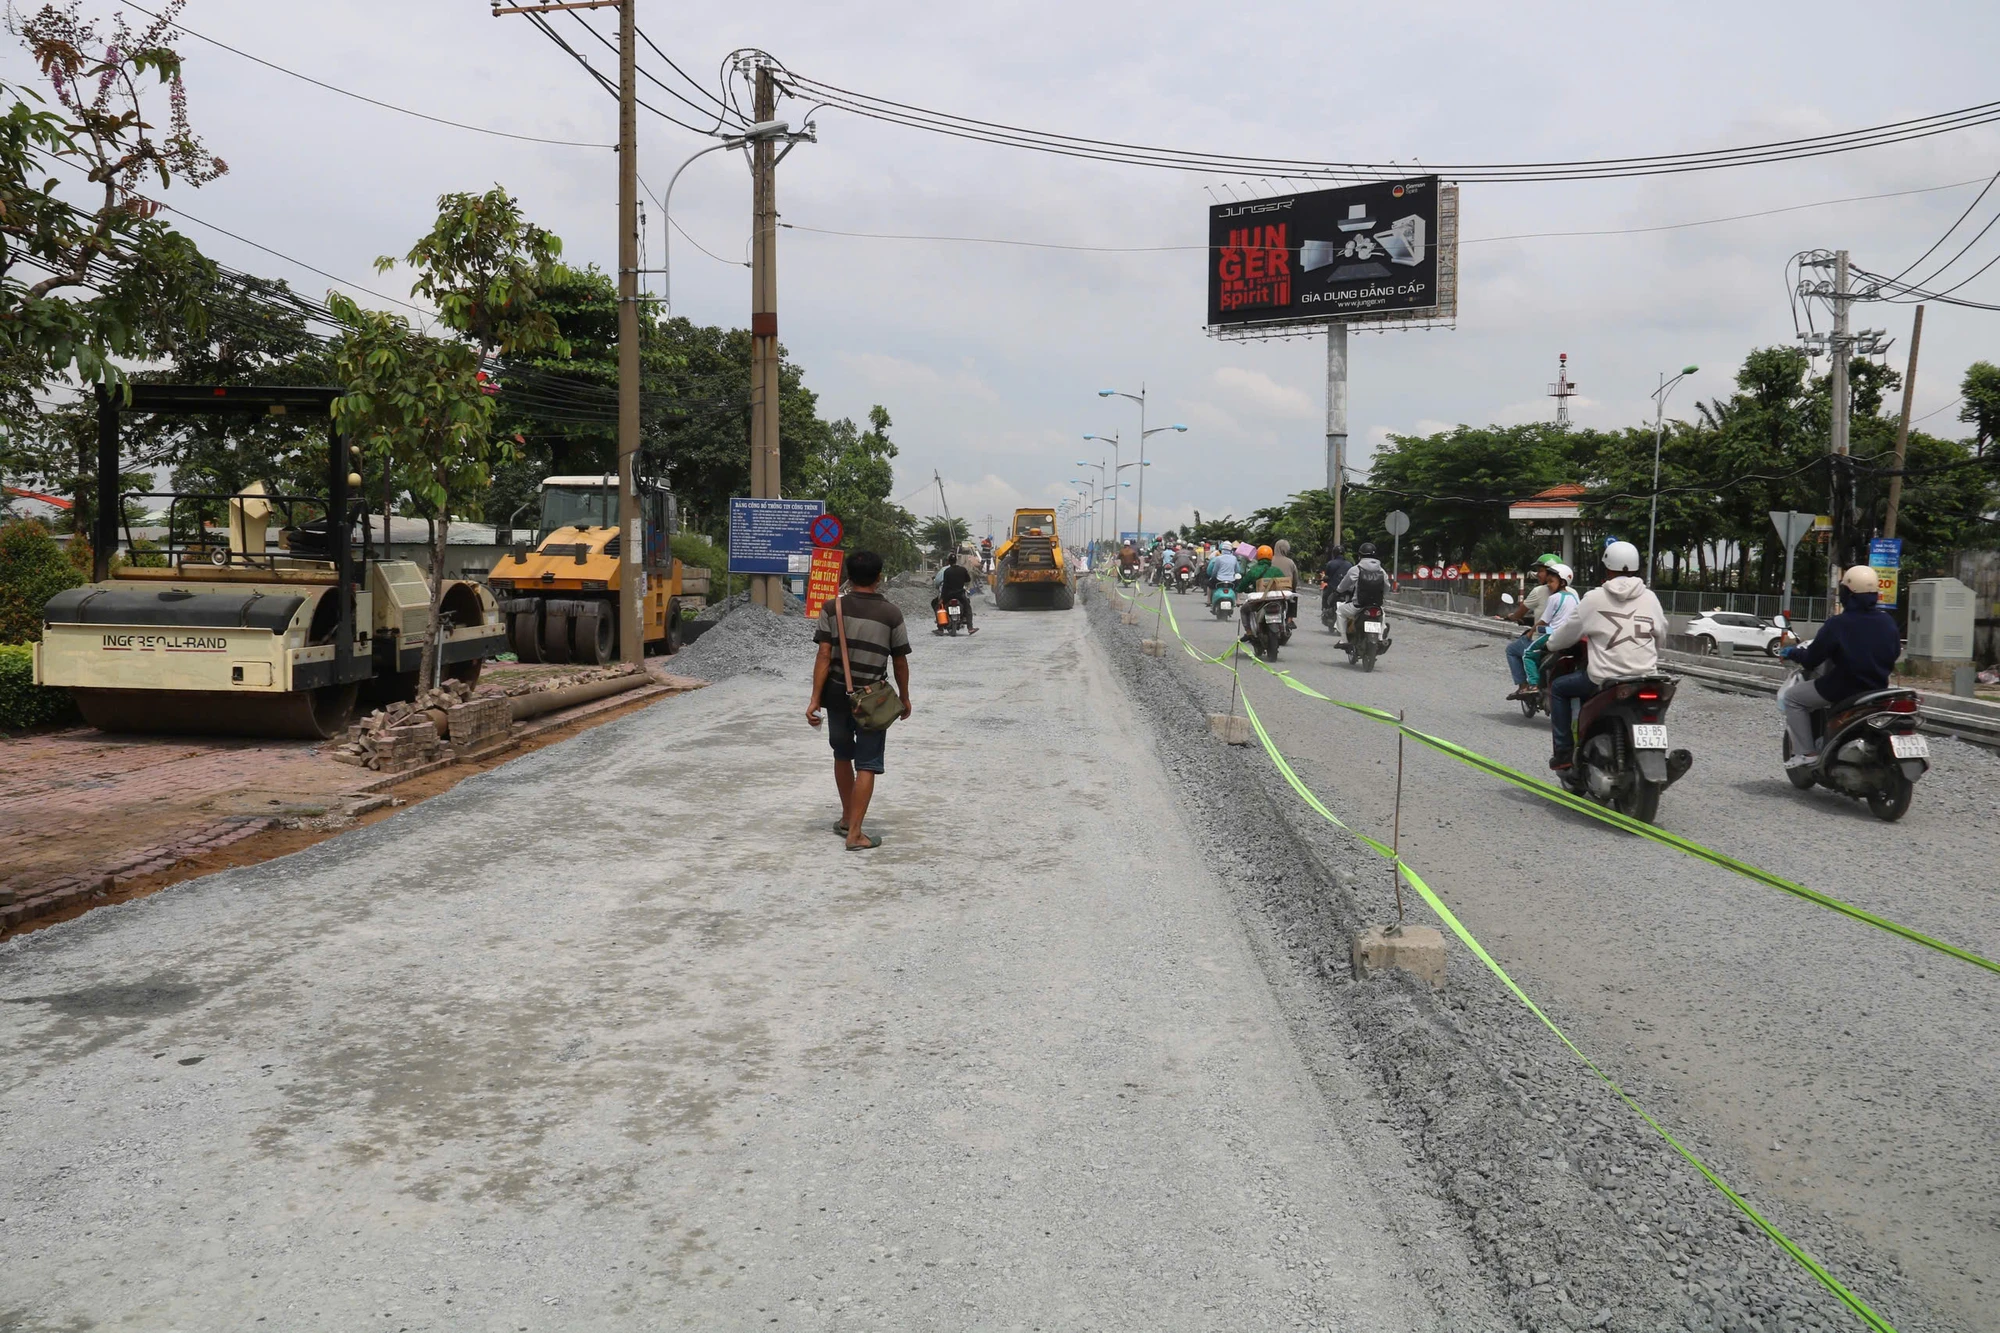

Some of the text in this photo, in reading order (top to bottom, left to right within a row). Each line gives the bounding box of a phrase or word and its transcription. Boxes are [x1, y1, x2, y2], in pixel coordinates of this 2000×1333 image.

[1219, 201, 1293, 218] JUNGER
[1219, 223, 1286, 254] JUN
[1219, 248, 1290, 281] GER
[1397, 279, 1425, 295] CẤP
[1337, 298, 1386, 308] www.junger.vn
